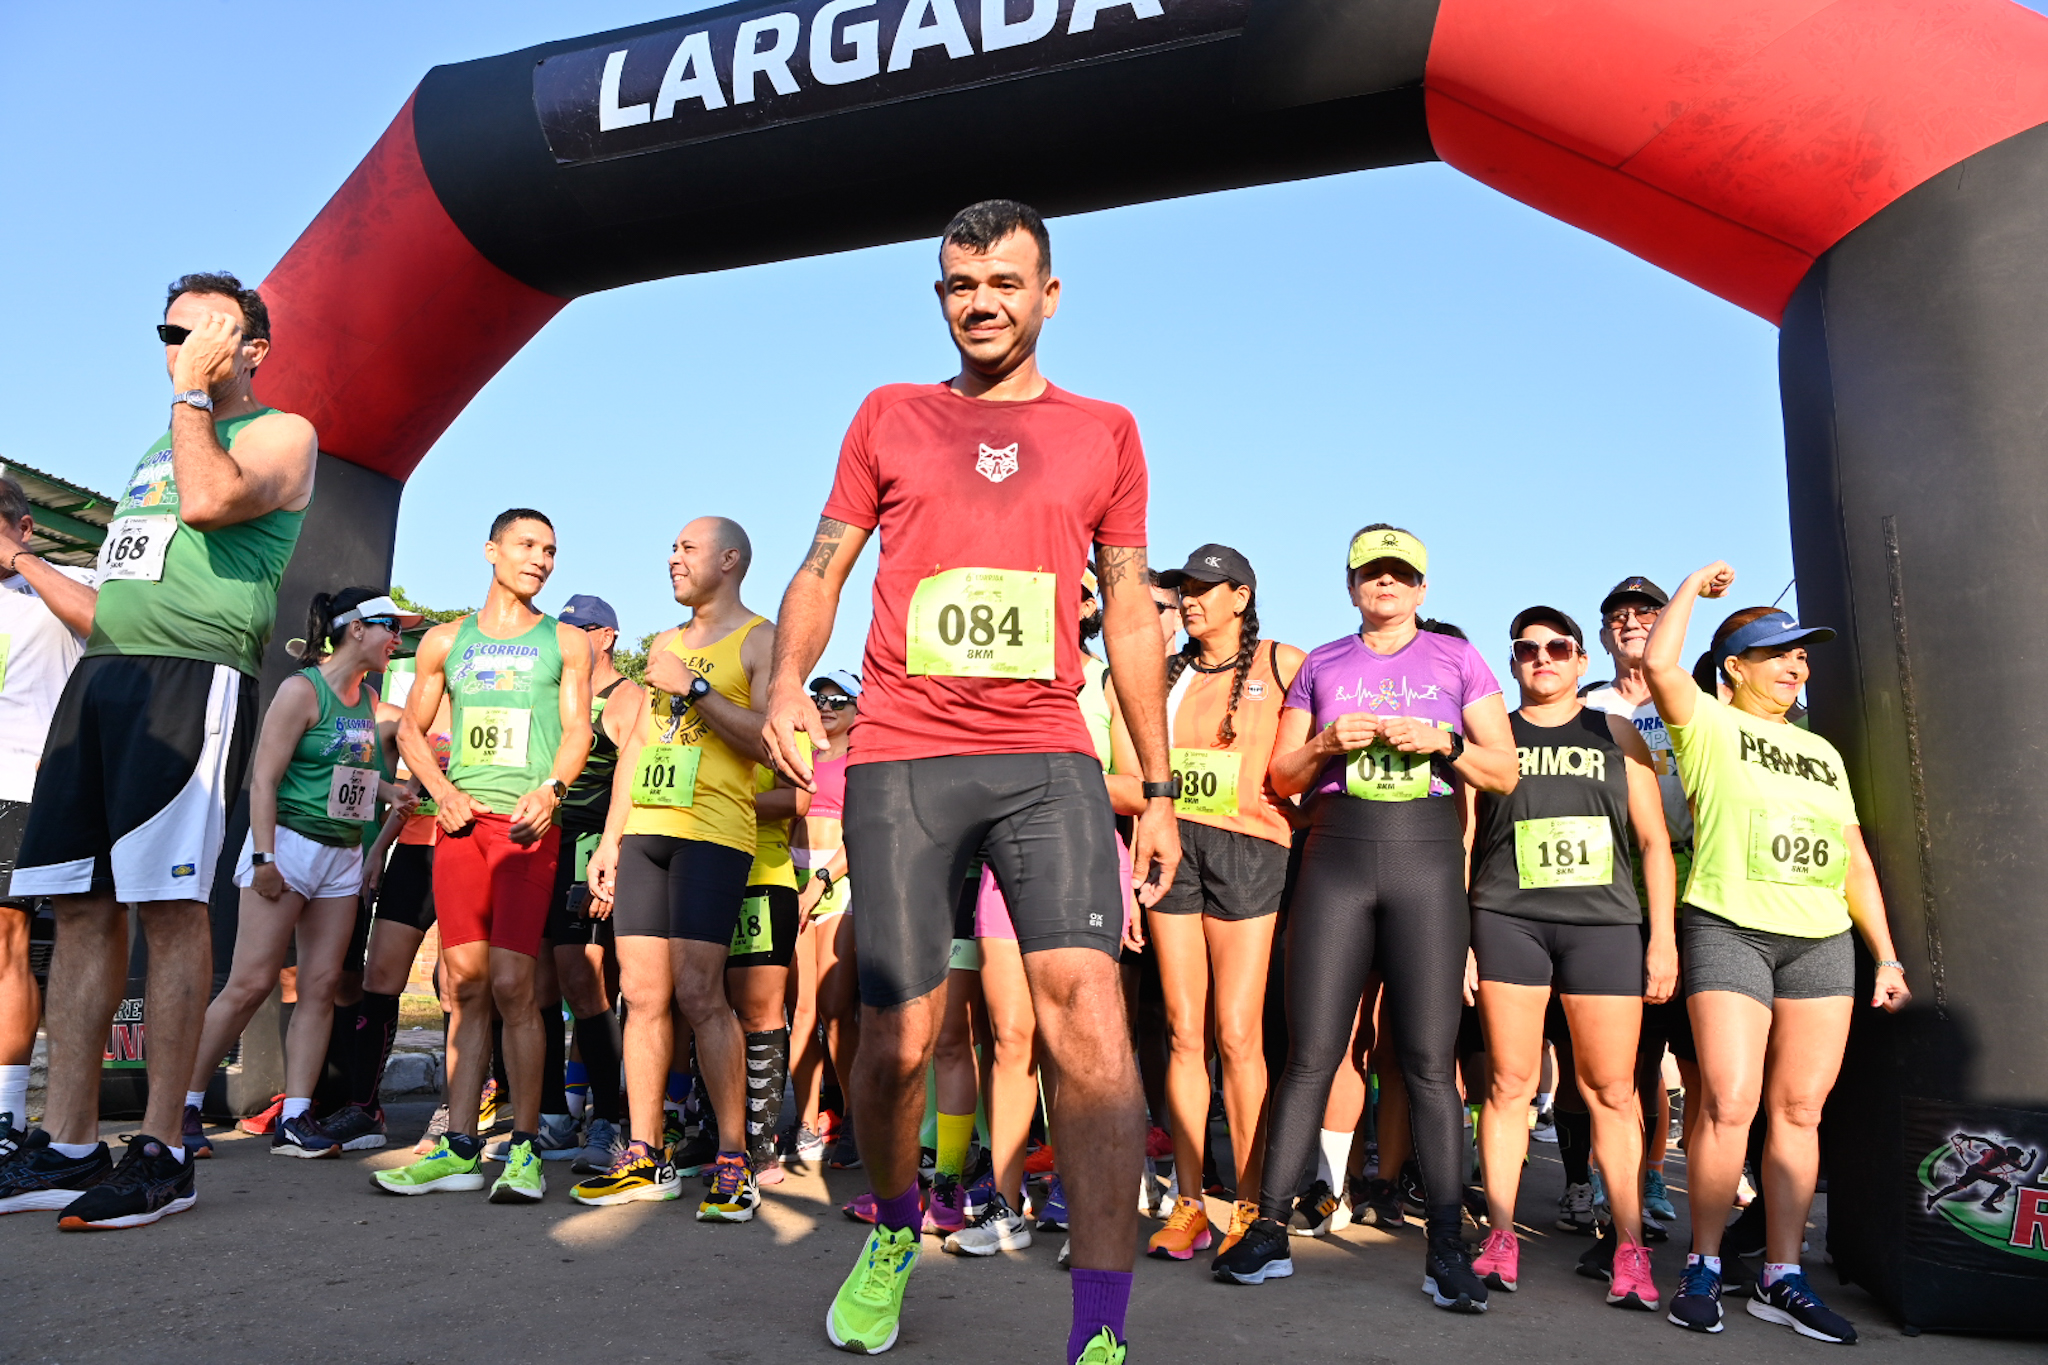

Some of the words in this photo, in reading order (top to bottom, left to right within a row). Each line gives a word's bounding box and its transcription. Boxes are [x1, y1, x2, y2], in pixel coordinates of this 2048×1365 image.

[105, 535, 149, 564] 168
[938, 604, 1023, 646] 084
[480, 644, 539, 657] CORRIDA
[967, 649, 994, 659] 8KM
[472, 656, 534, 671] EXPO
[470, 726, 513, 749] 081
[642, 764, 675, 788] 101
[1357, 754, 1414, 781] 011
[1516, 746, 1605, 782] RIMOR
[338, 783, 366, 806] 057
[1538, 839, 1590, 867] 181
[1772, 834, 1829, 866] 026
